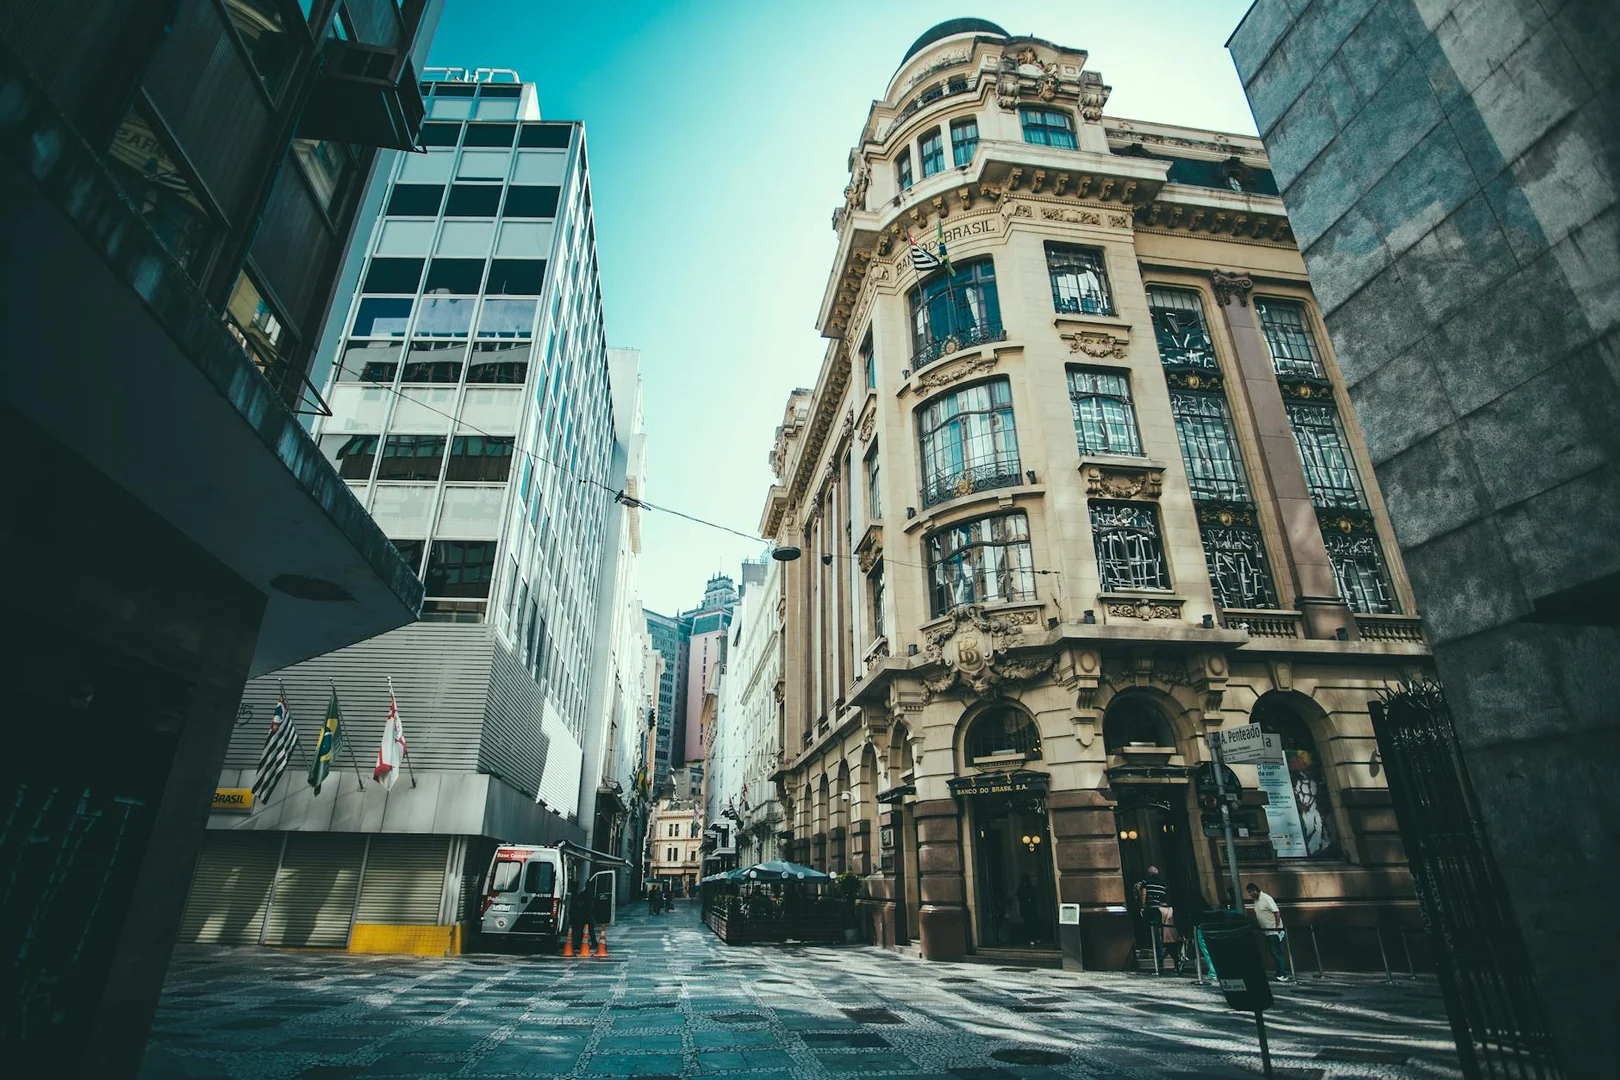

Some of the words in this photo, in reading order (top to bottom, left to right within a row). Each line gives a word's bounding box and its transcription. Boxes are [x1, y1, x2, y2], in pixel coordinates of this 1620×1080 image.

[943, 221, 995, 243] BRASIL
[1221, 731, 1228, 744] A.
[1228, 725, 1260, 743] Penteado
[213, 793, 244, 804] BRASIL
